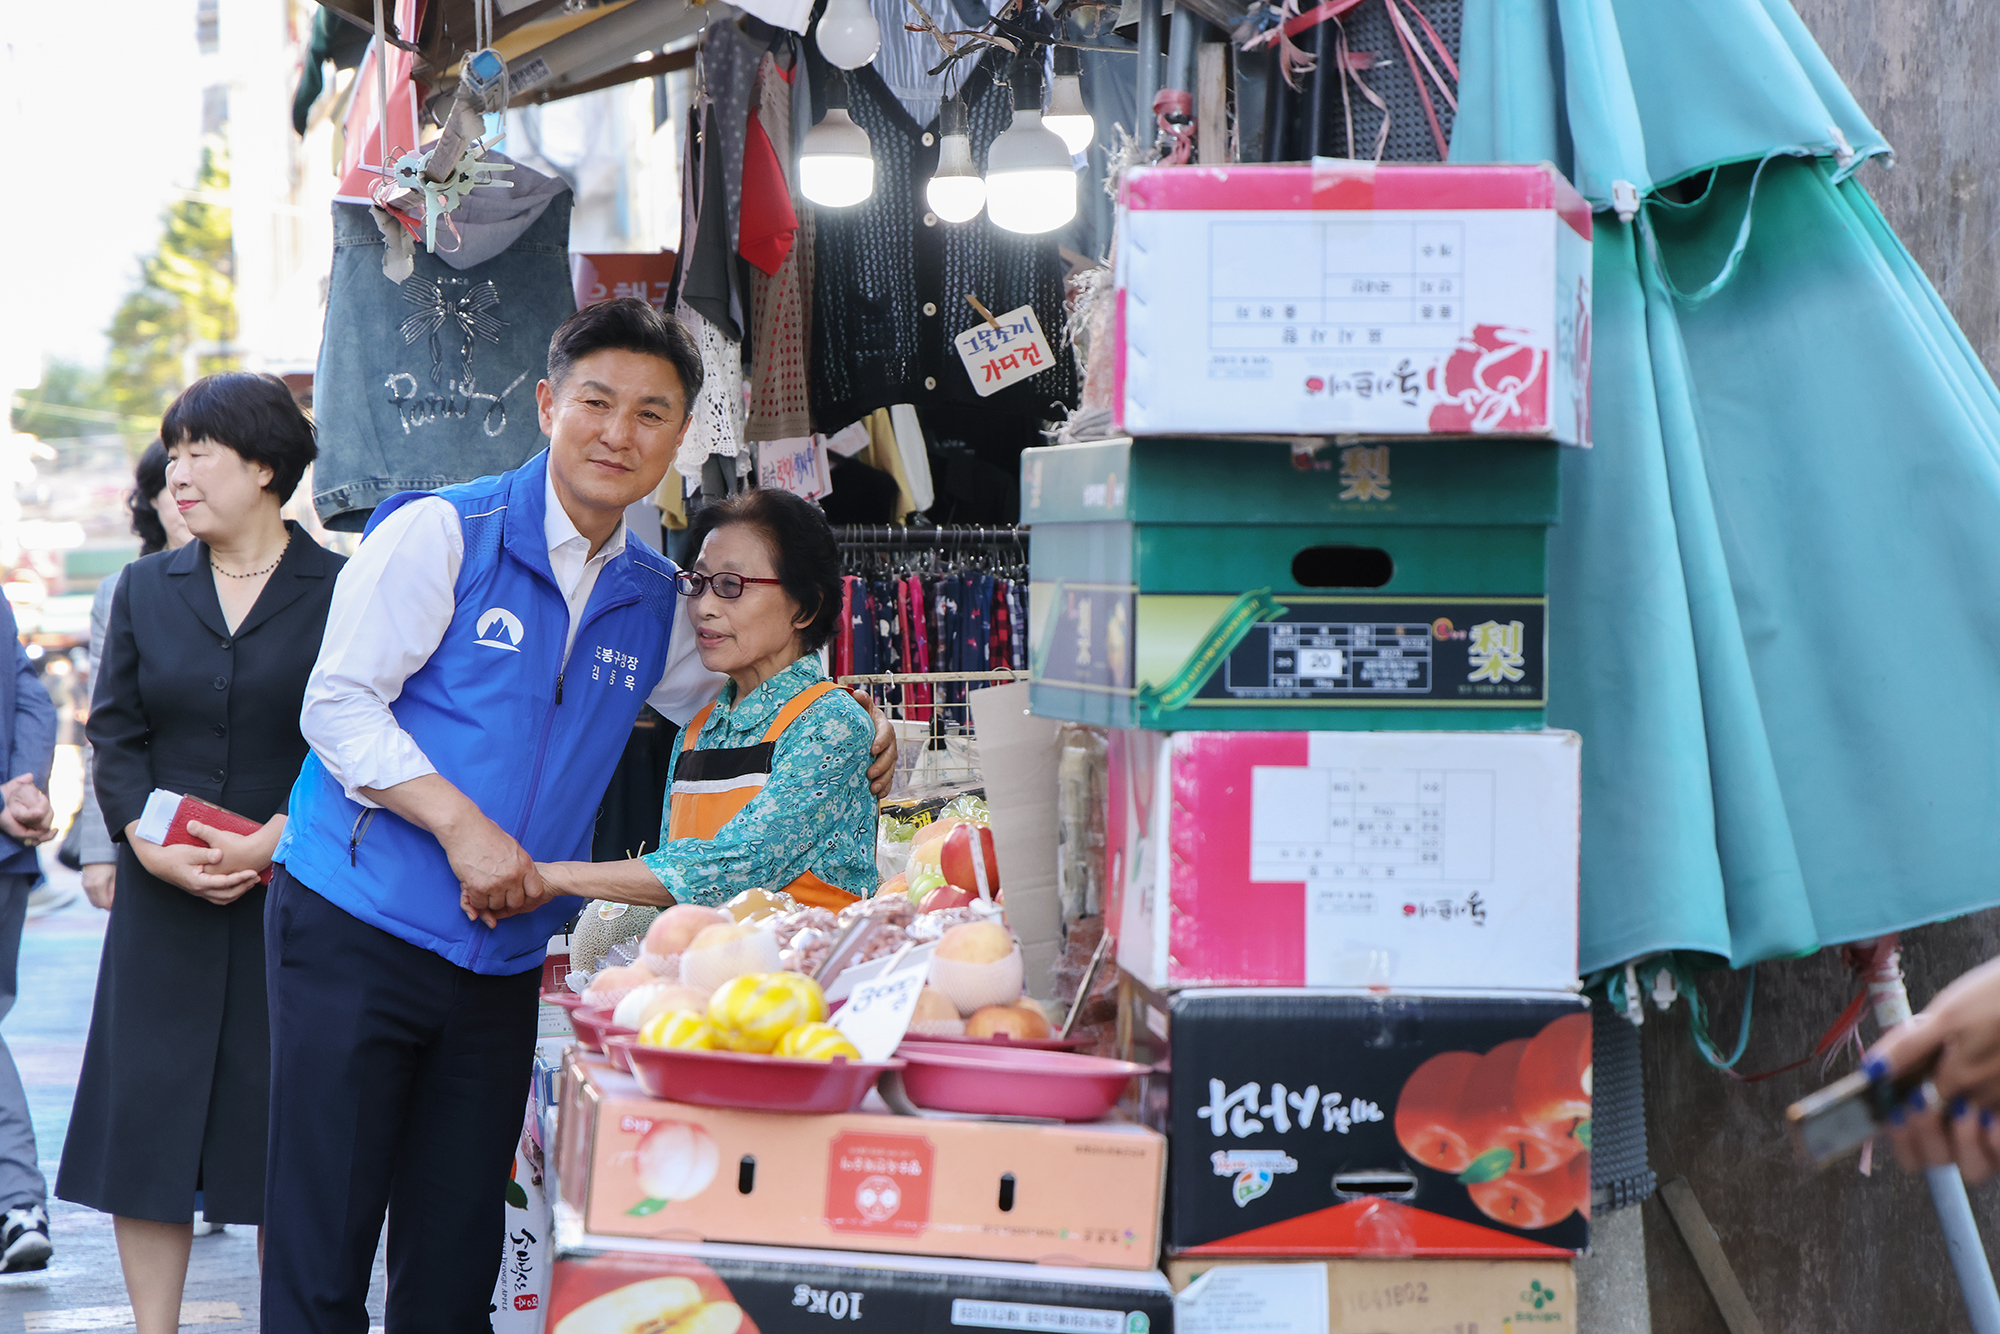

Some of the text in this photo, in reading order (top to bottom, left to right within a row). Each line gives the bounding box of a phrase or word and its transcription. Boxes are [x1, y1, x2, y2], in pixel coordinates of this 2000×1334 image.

[963, 316, 1034, 356] 그물조끼
[980, 341, 1044, 383] 가디건
[1467, 619, 1526, 684] 梨
[514, 1296, 538, 1309] 영주
